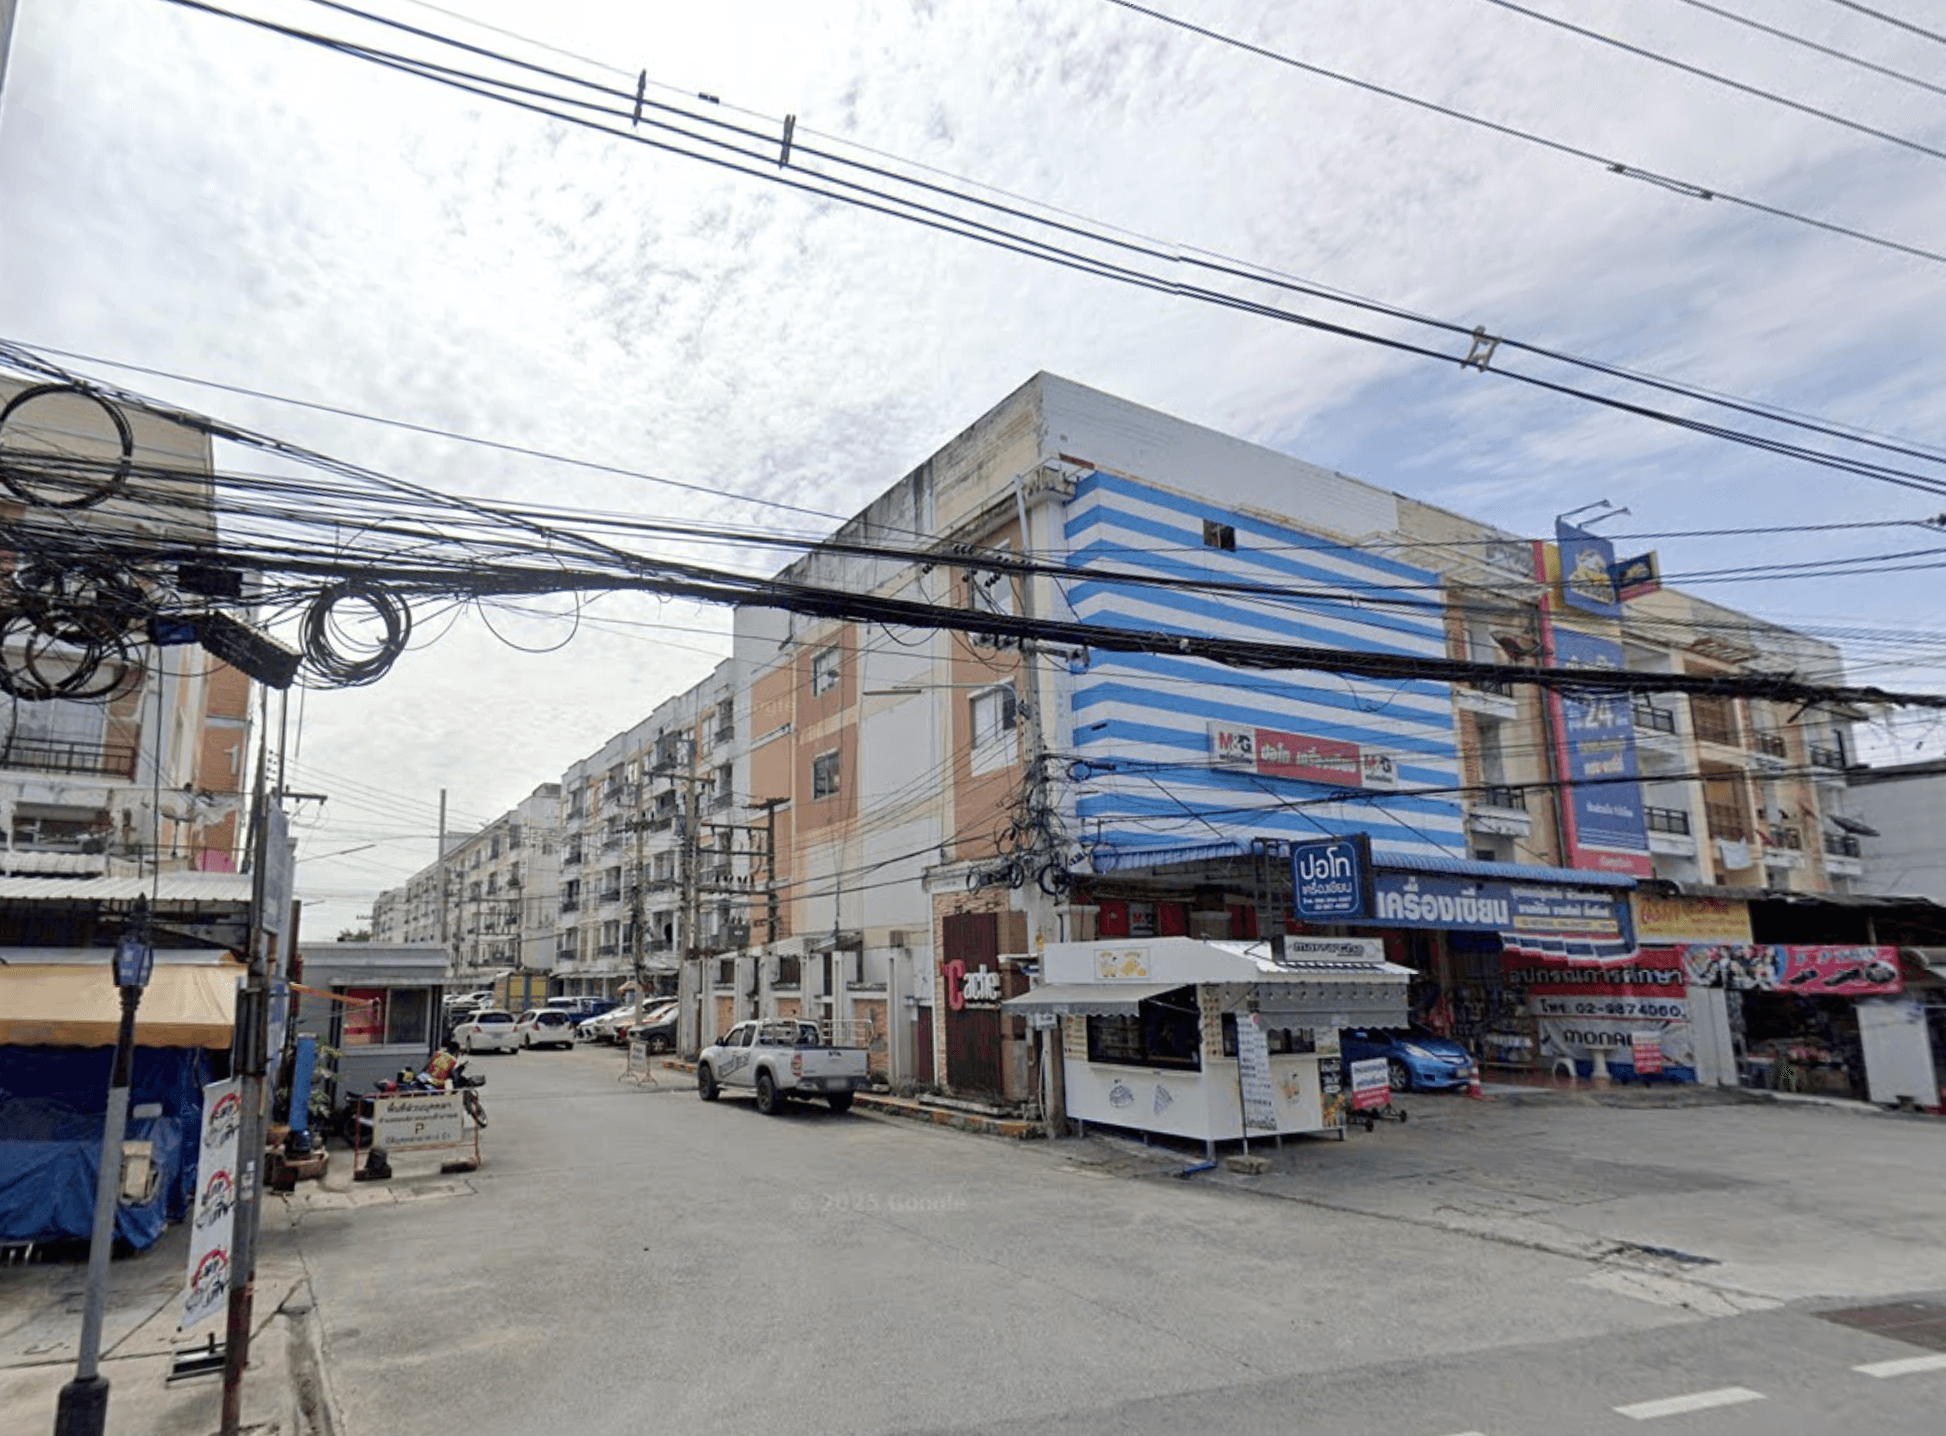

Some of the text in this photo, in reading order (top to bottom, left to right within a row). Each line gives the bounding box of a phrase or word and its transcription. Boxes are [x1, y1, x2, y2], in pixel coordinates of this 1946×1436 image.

[1300, 846, 1352, 880] ปอโท
[1376, 876, 1510, 924] เครื่องเขียน
[1508, 965, 1683, 986] อุปกรณการศึกษา
